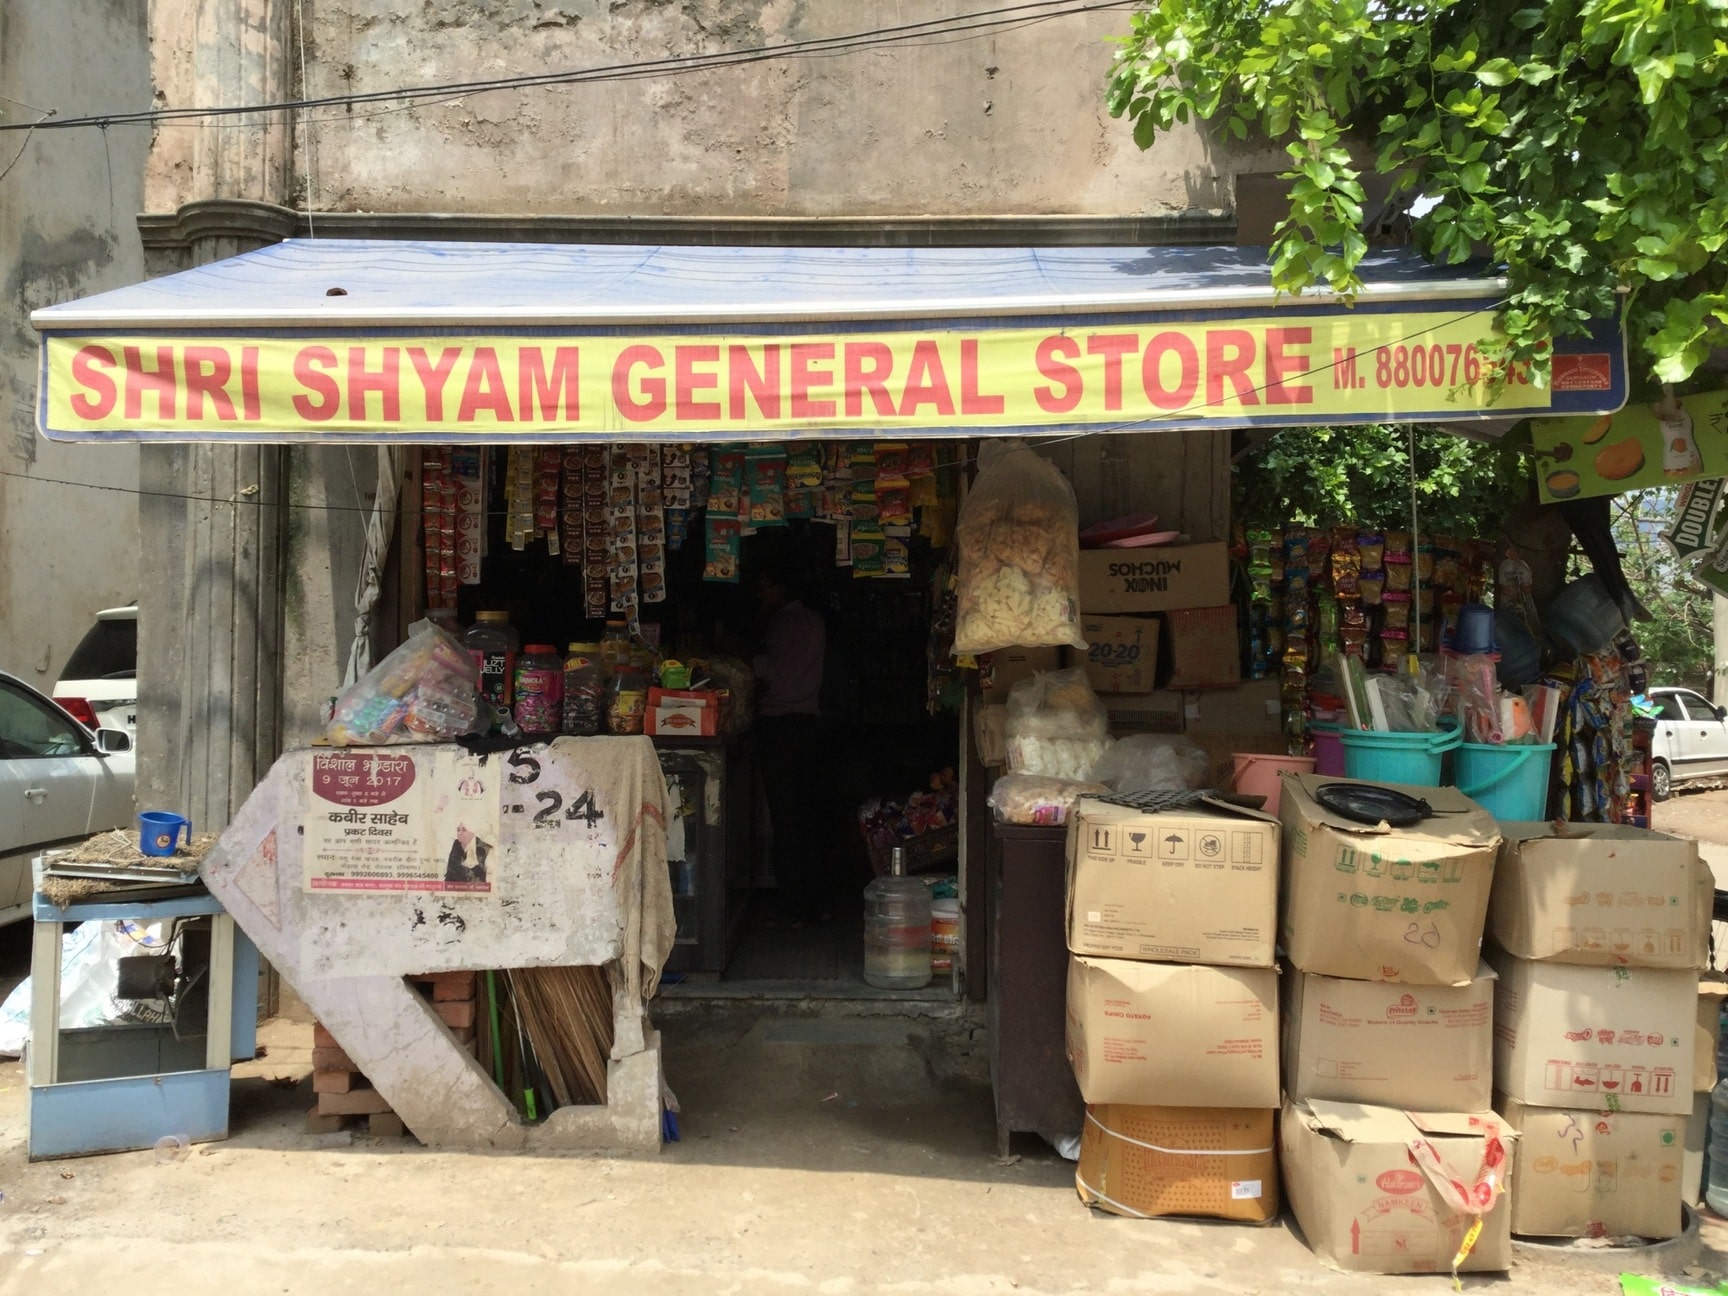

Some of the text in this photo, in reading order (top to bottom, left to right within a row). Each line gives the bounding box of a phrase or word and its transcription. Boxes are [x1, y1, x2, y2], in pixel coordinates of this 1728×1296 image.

[70, 326, 1314, 424] SHRI SHYAM GENERAL STORE
[1333, 347, 1366, 390] M.
[1675, 478, 1720, 547] DOUBLE
[1108, 560, 1182, 577] MUCHOS
[1124, 577, 1168, 593] INOX
[1088, 642, 1141, 660] 20-20
[322, 774, 402, 788] 9 जून 2017
